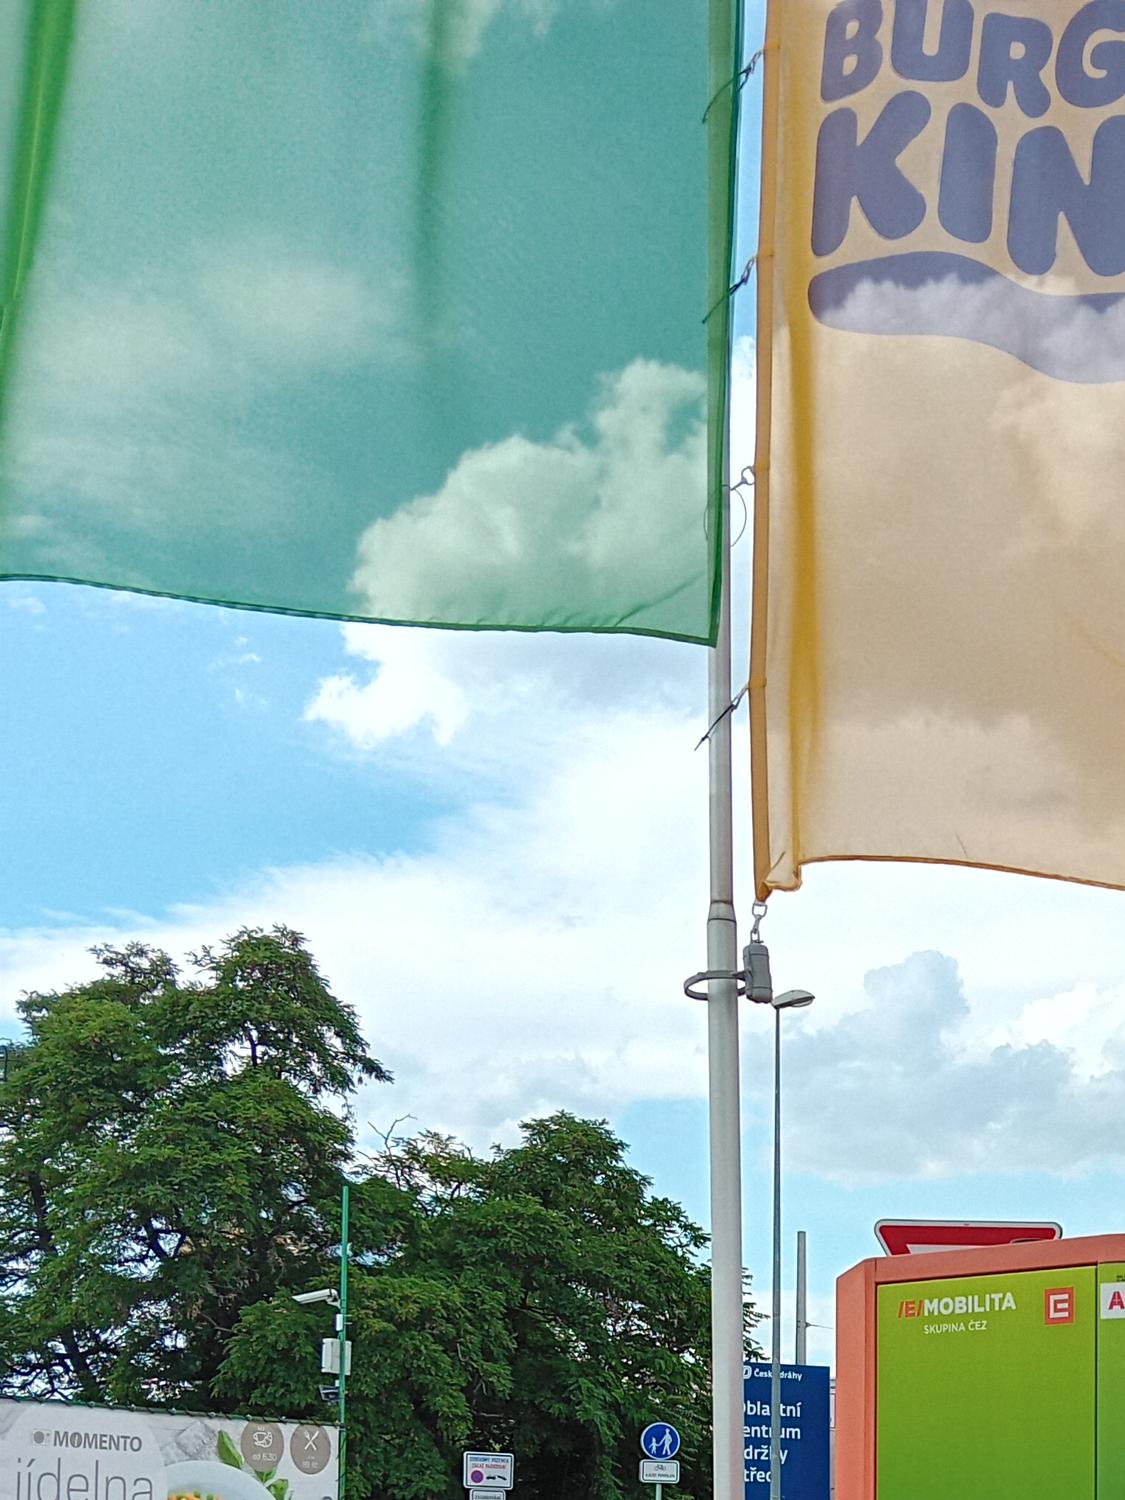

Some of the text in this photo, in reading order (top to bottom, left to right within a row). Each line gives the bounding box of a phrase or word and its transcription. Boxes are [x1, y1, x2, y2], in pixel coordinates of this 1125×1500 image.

[923, 1319, 988, 1335] SKUPINA ČEZ
[754, 1368, 772, 1378] Česk
[743, 1400, 802, 1417] blatní
[53, 1430, 142, 1452] MOMENTO
[744, 1444, 788, 1464] držy
